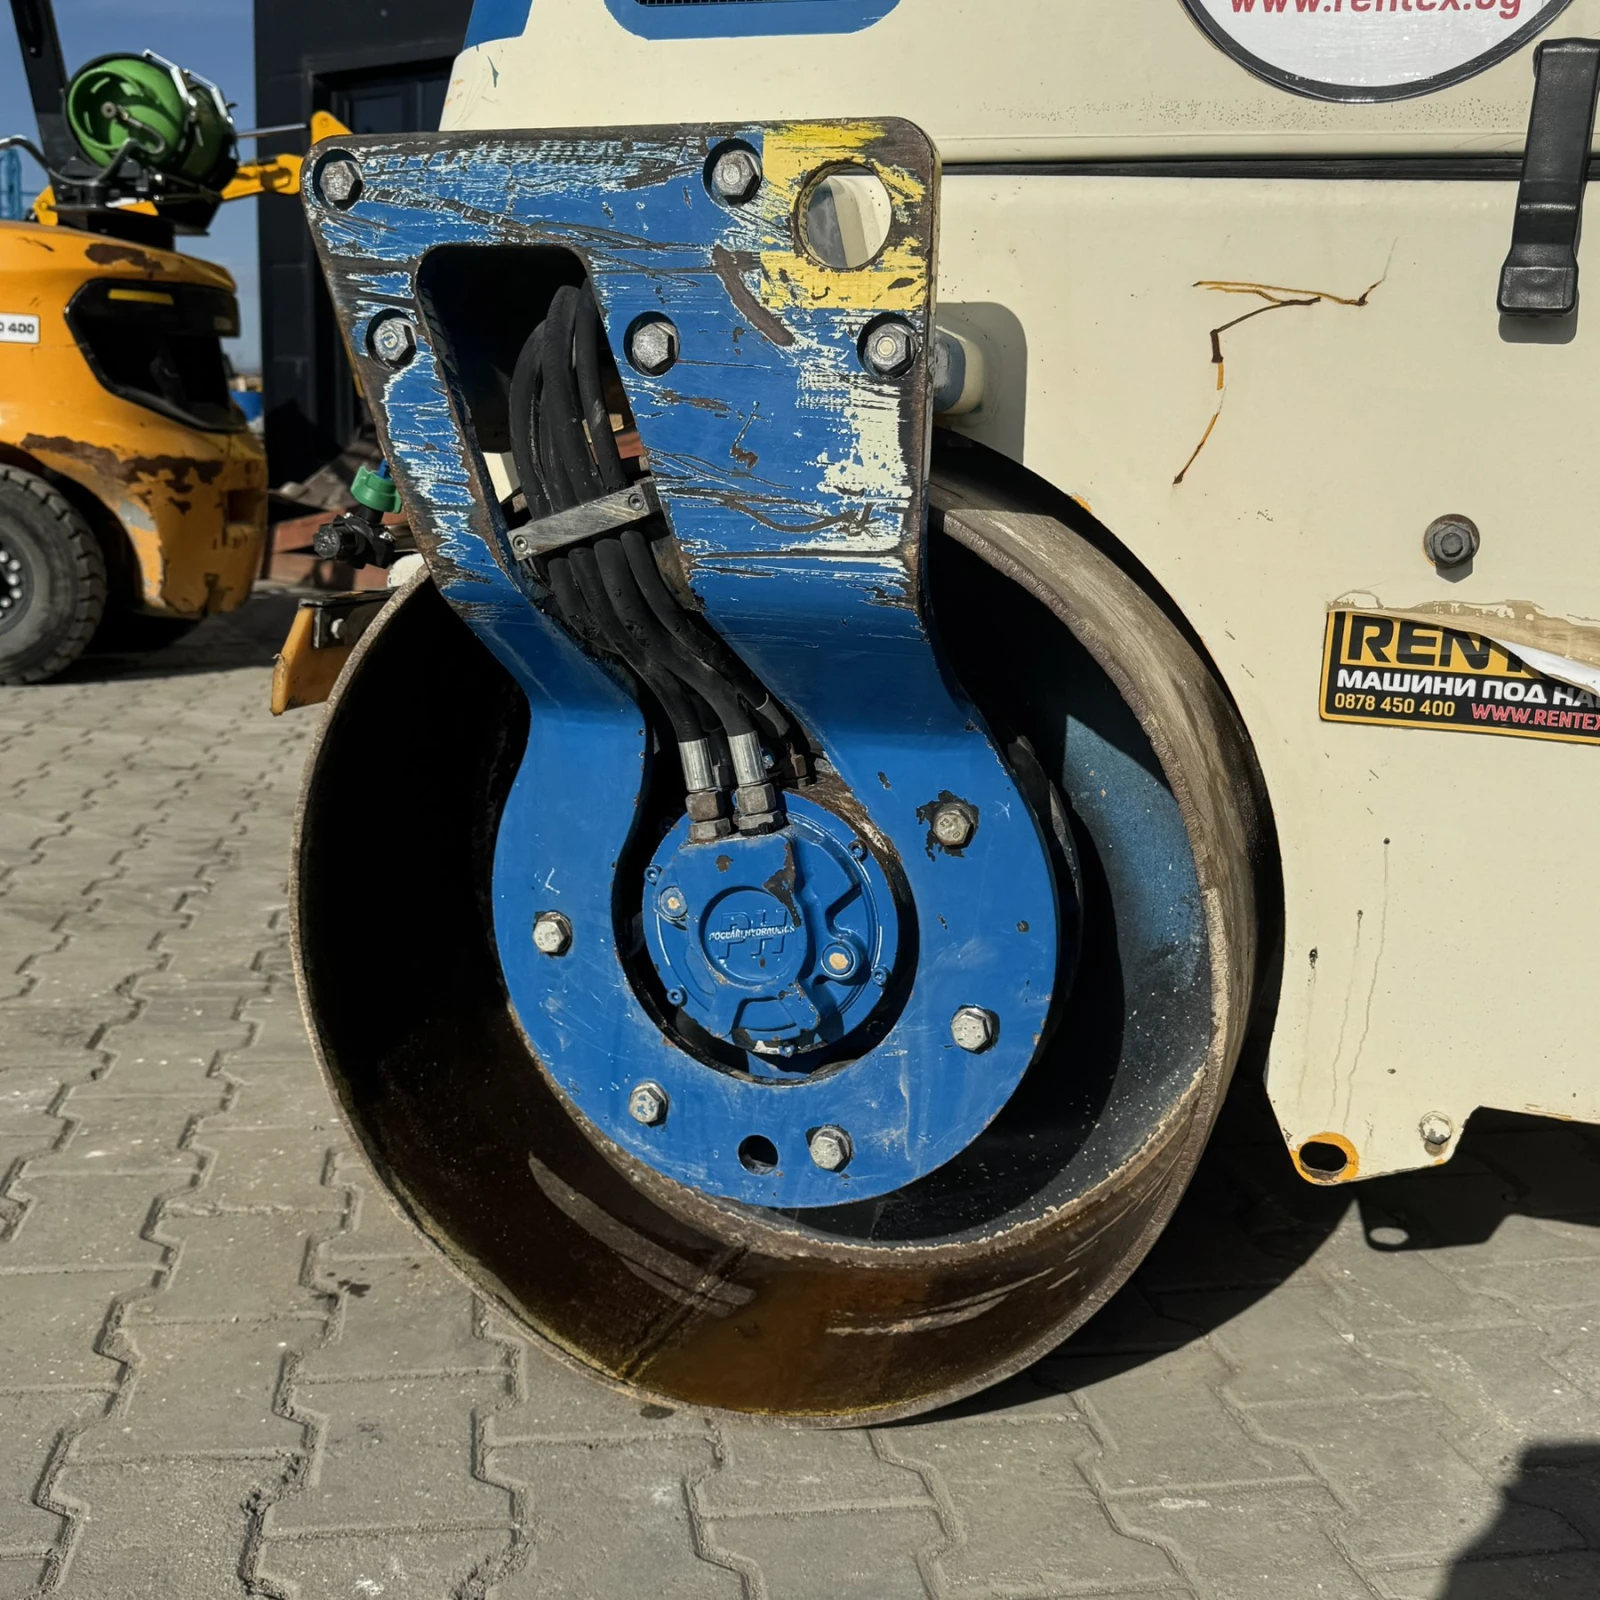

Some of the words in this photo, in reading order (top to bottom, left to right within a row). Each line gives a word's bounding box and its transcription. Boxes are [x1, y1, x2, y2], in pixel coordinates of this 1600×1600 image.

[8, 322, 35, 334] 400
[1336, 669, 1476, 698] МАШИНИ
[1482, 680, 1548, 704] ПОД
[1552, 686, 1600, 709] НА
[1334, 692, 1376, 711] 0878
[1380, 696, 1415, 714] 450
[1419, 698, 1456, 717] 400
